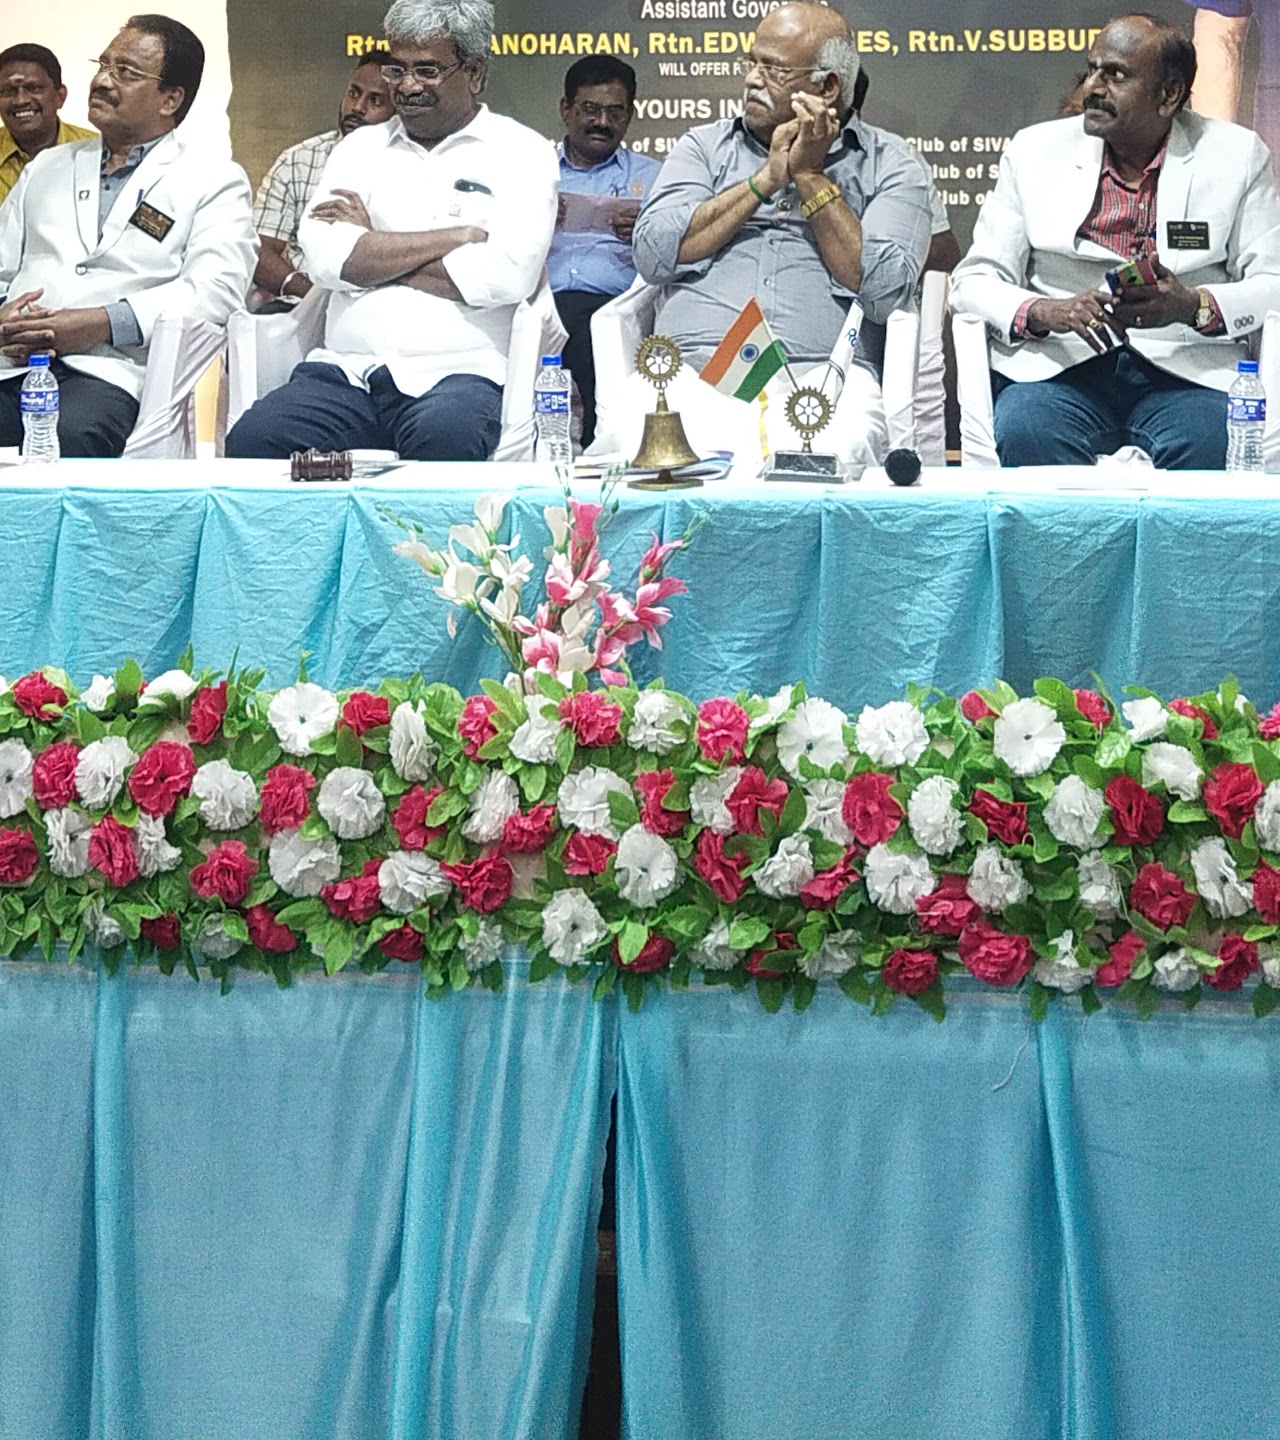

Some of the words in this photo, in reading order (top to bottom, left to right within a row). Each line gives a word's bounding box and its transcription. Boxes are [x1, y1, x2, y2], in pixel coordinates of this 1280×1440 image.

[658, 63, 687, 77] WILL
[690, 62, 731, 76] OFFER
[633, 99, 711, 119] YOURS
[632, 137, 650, 153] of
[950, 136, 969, 152] of
[933, 163, 960, 179] lub
[965, 163, 984, 179] of
[937, 189, 970, 205] lub
